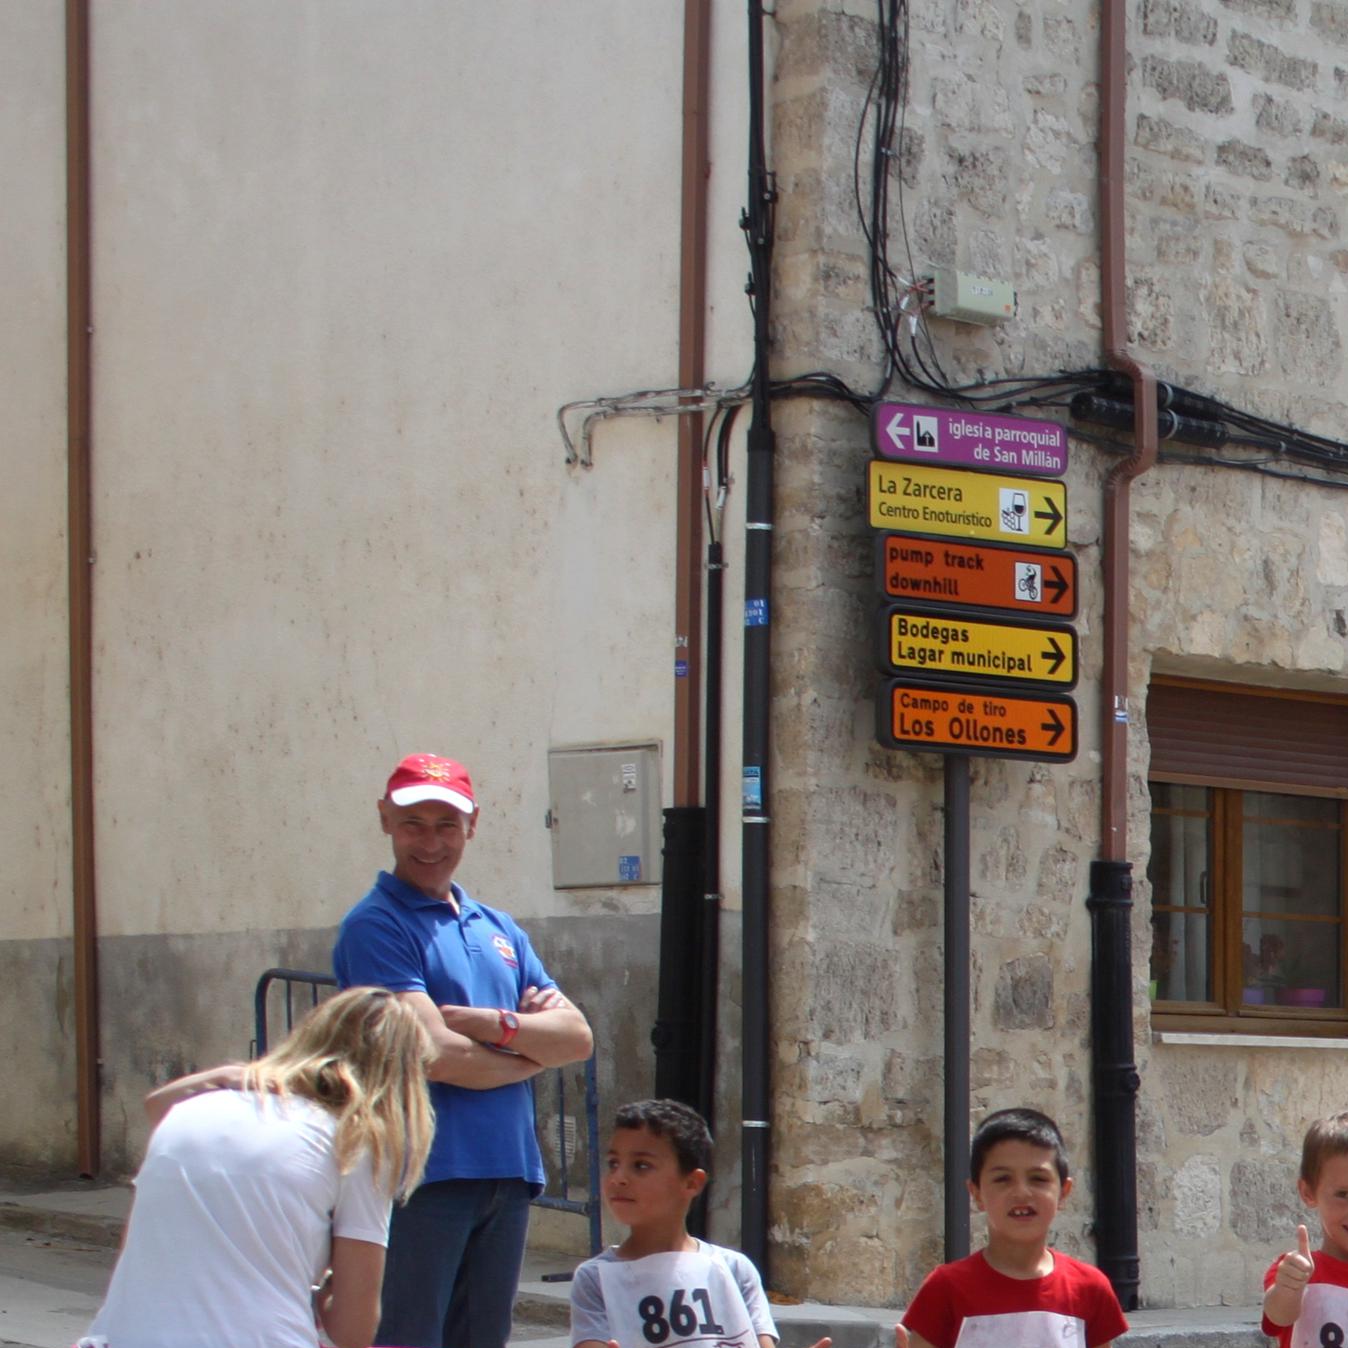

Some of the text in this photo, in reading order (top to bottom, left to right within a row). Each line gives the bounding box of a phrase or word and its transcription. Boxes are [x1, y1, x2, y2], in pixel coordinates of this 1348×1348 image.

[948, 417, 1061, 448] iglesia parroquial
[973, 443, 1061, 469] de San Millán
[878, 475, 963, 502] La Zarcera
[878, 501, 992, 528] Centro Enoturístico
[889, 547, 984, 571] pump track
[890, 571, 960, 597] downhill
[897, 618, 970, 644] Bodegas
[897, 640, 1033, 673] Lagar municipal
[900, 693, 1007, 718] Campo de tiro
[899, 713, 1027, 745] Los Ollones
[638, 1287, 725, 1344] 861
